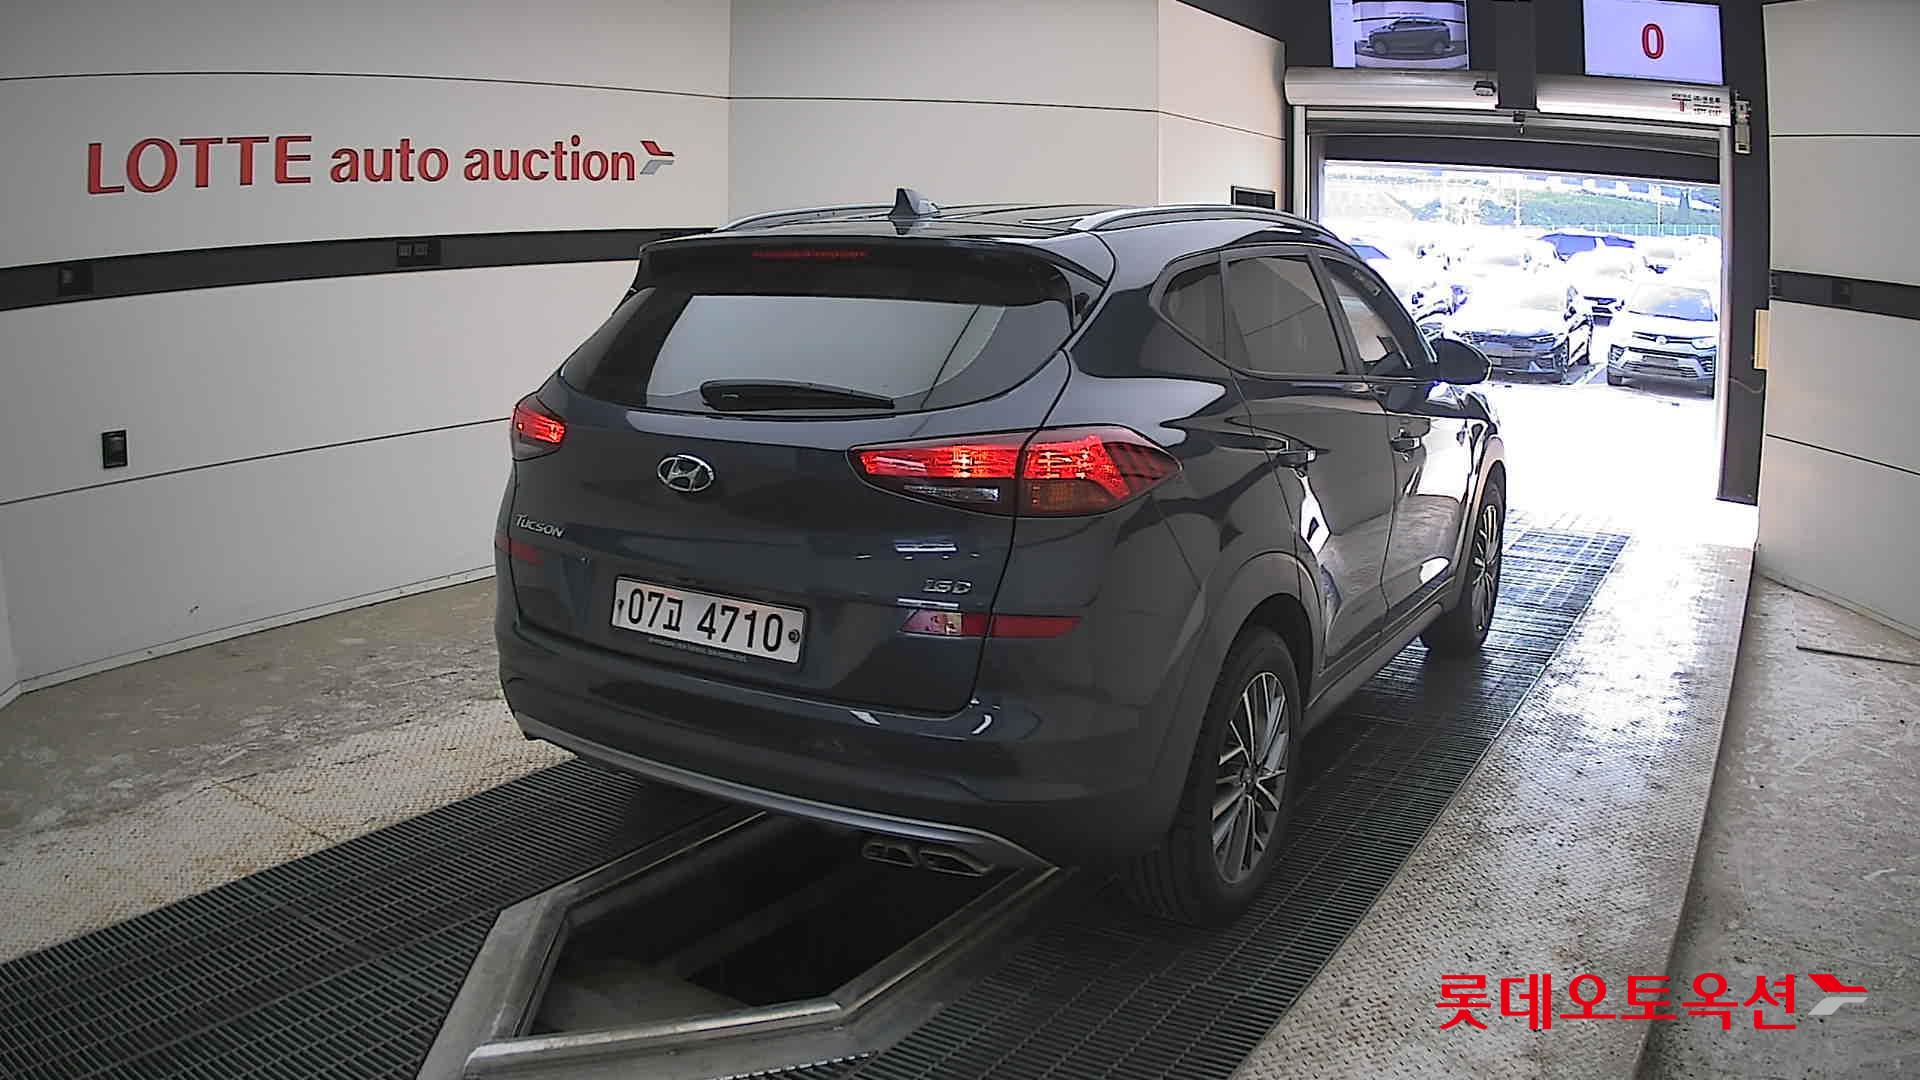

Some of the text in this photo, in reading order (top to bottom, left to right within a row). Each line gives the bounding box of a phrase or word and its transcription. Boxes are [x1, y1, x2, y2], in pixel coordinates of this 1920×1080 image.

[1642, 23, 1664, 59] 0
[87, 134, 636, 195] LOTTE auto auction
[628, 588, 684, 632] 07고
[696, 602, 783, 652] 4710
